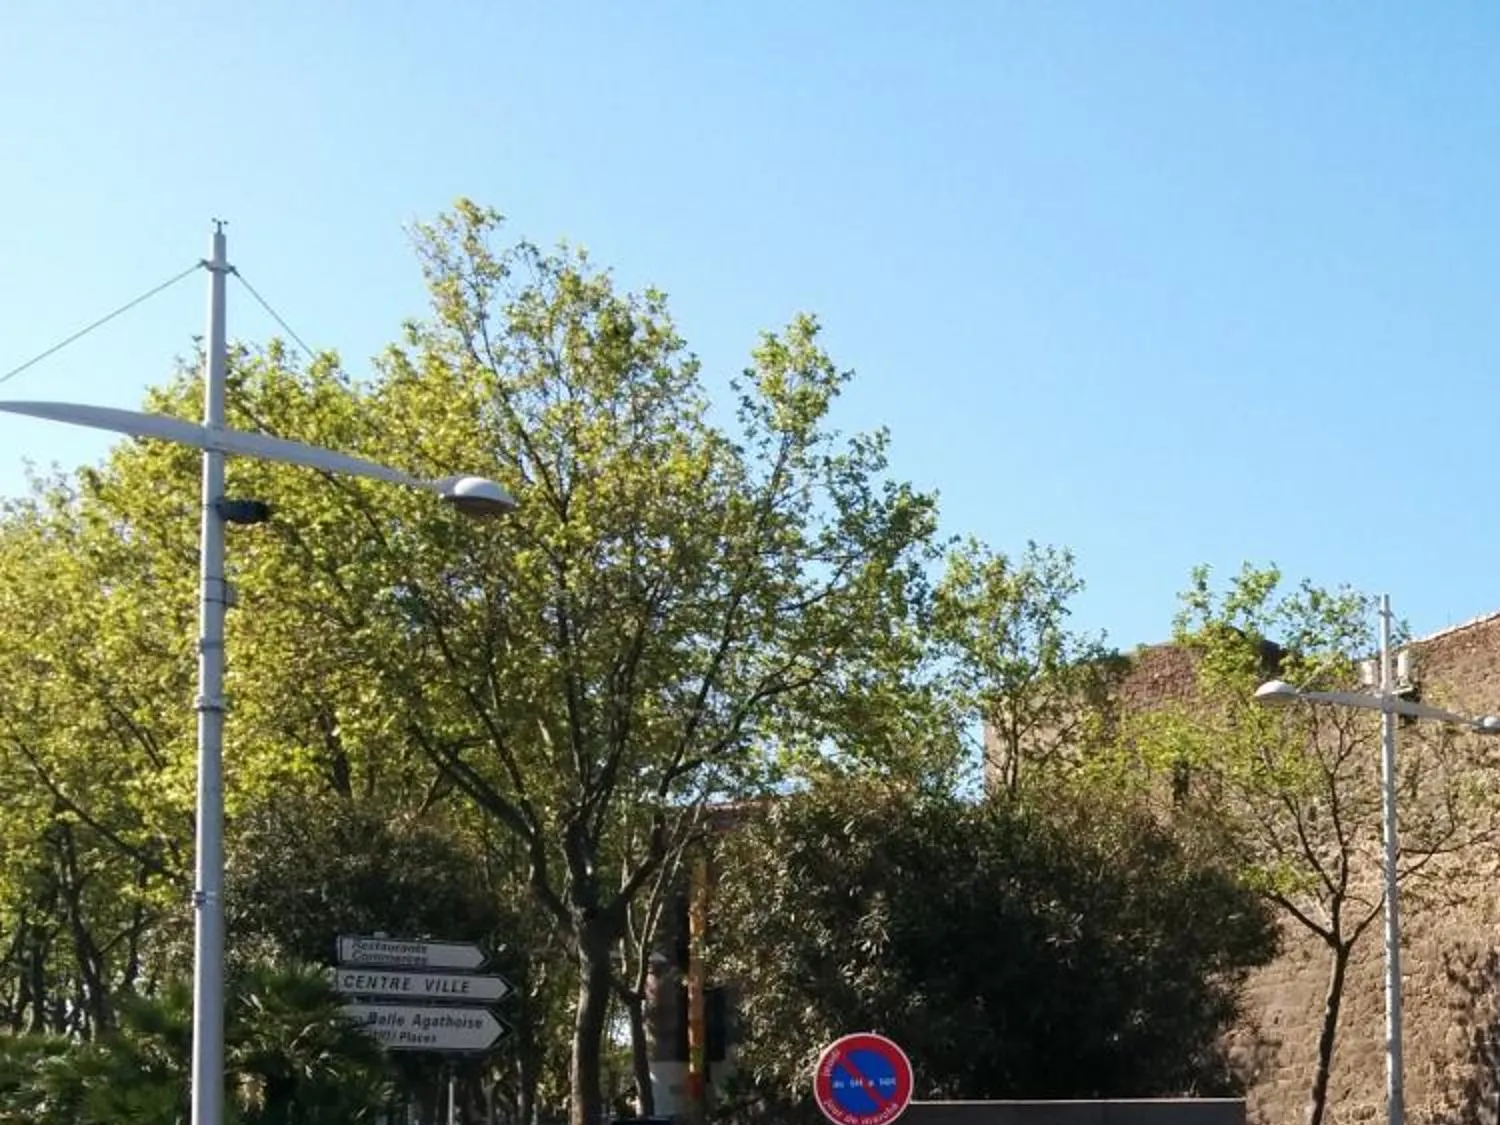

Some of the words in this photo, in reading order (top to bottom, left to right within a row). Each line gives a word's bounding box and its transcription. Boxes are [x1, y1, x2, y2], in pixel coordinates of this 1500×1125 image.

[343, 975, 411, 991] CENTRE
[424, 978, 472, 993] VILLE
[367, 1010, 406, 1027] Belle
[411, 1013, 484, 1031] Agathoise
[399, 1031, 437, 1043] Places
